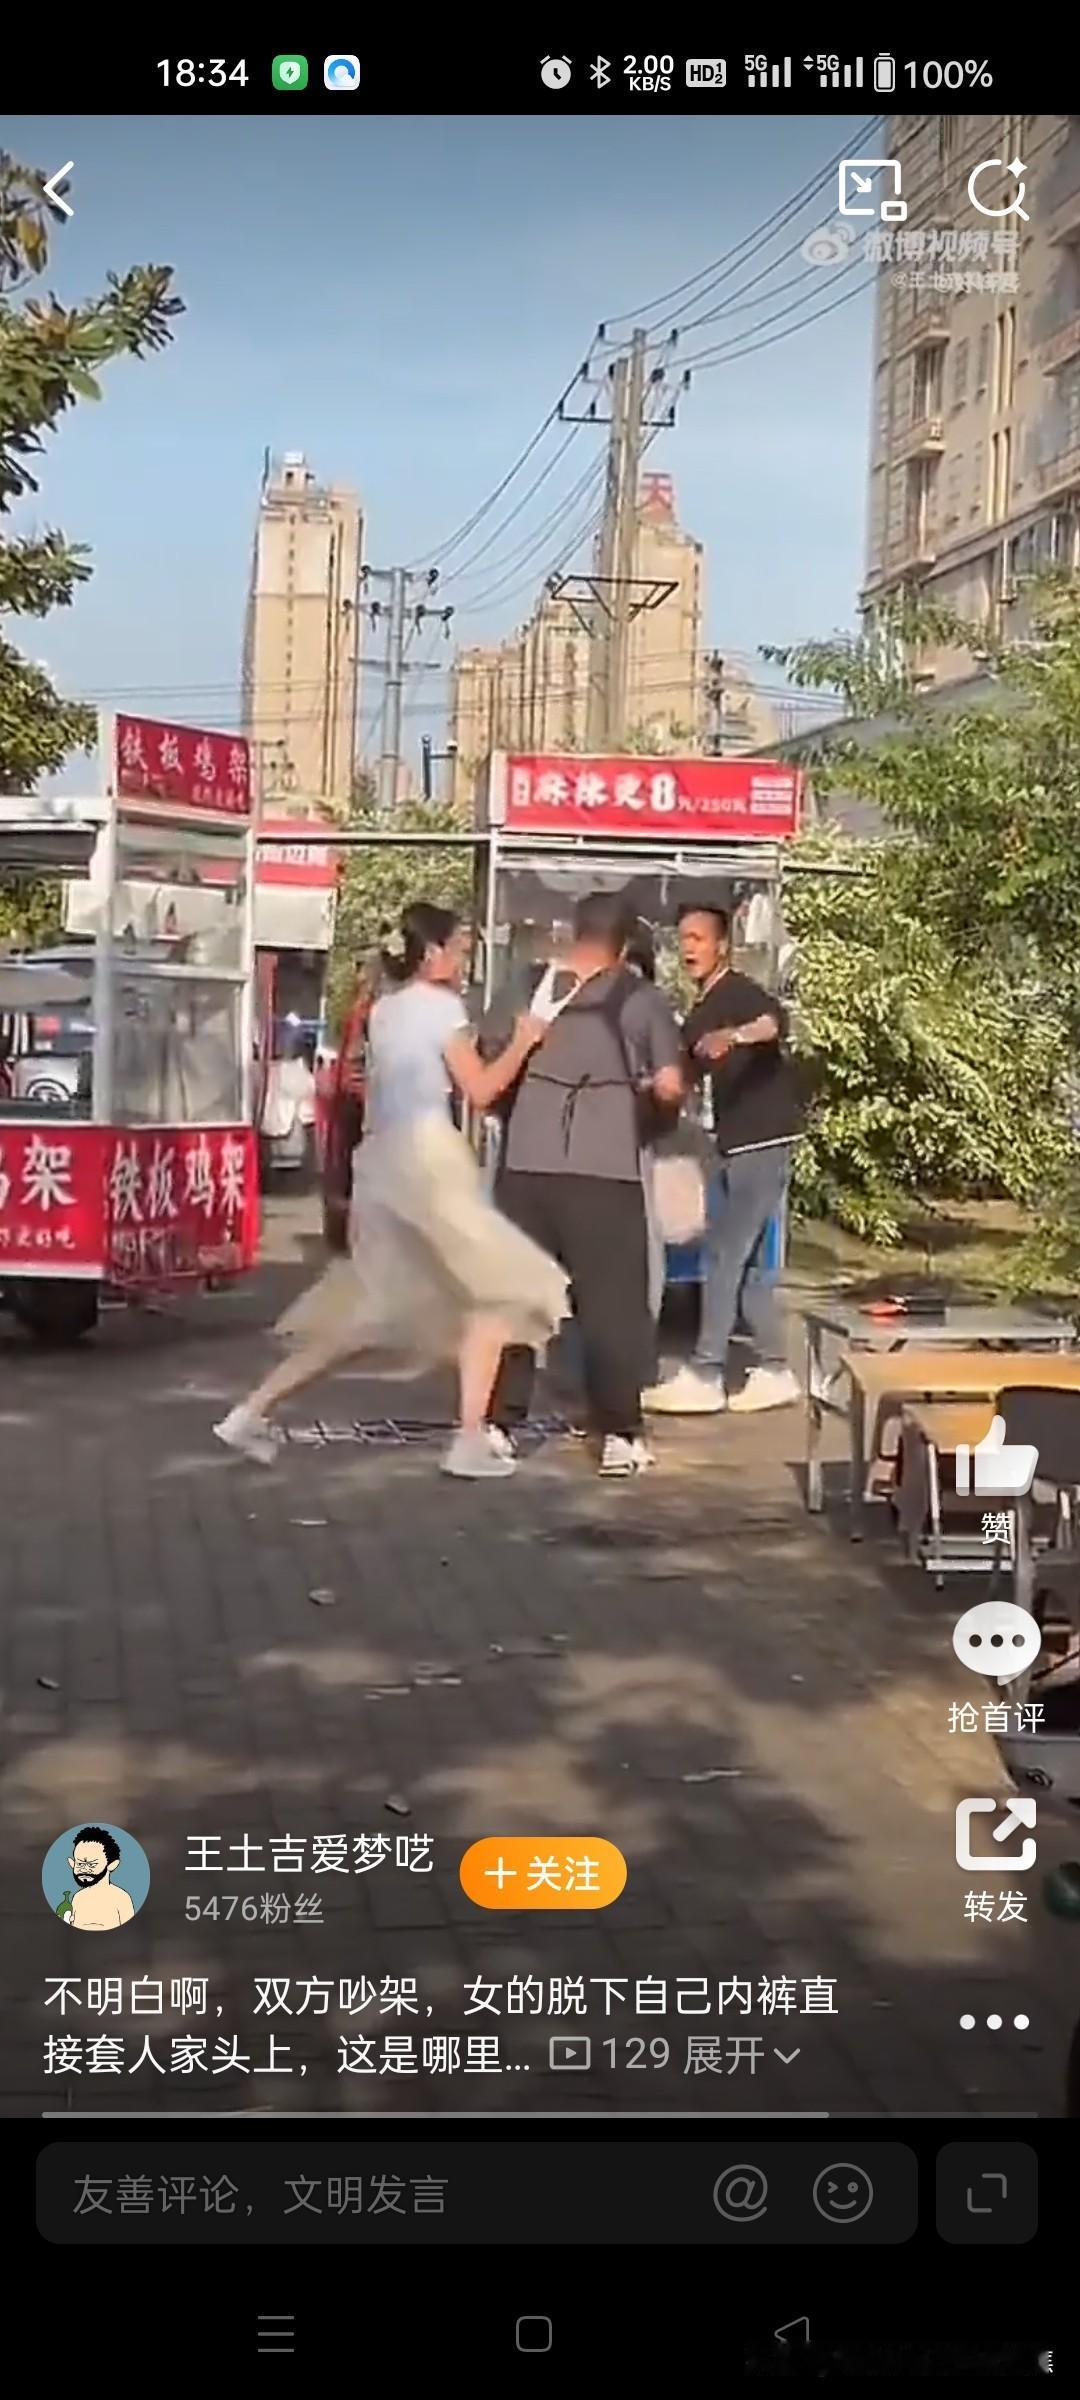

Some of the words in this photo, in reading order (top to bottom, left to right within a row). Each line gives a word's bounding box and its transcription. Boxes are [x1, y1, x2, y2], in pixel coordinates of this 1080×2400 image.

[120, 725, 248, 785] 铁板鸡架
[110, 1132, 245, 1222] 铁板鸡架
